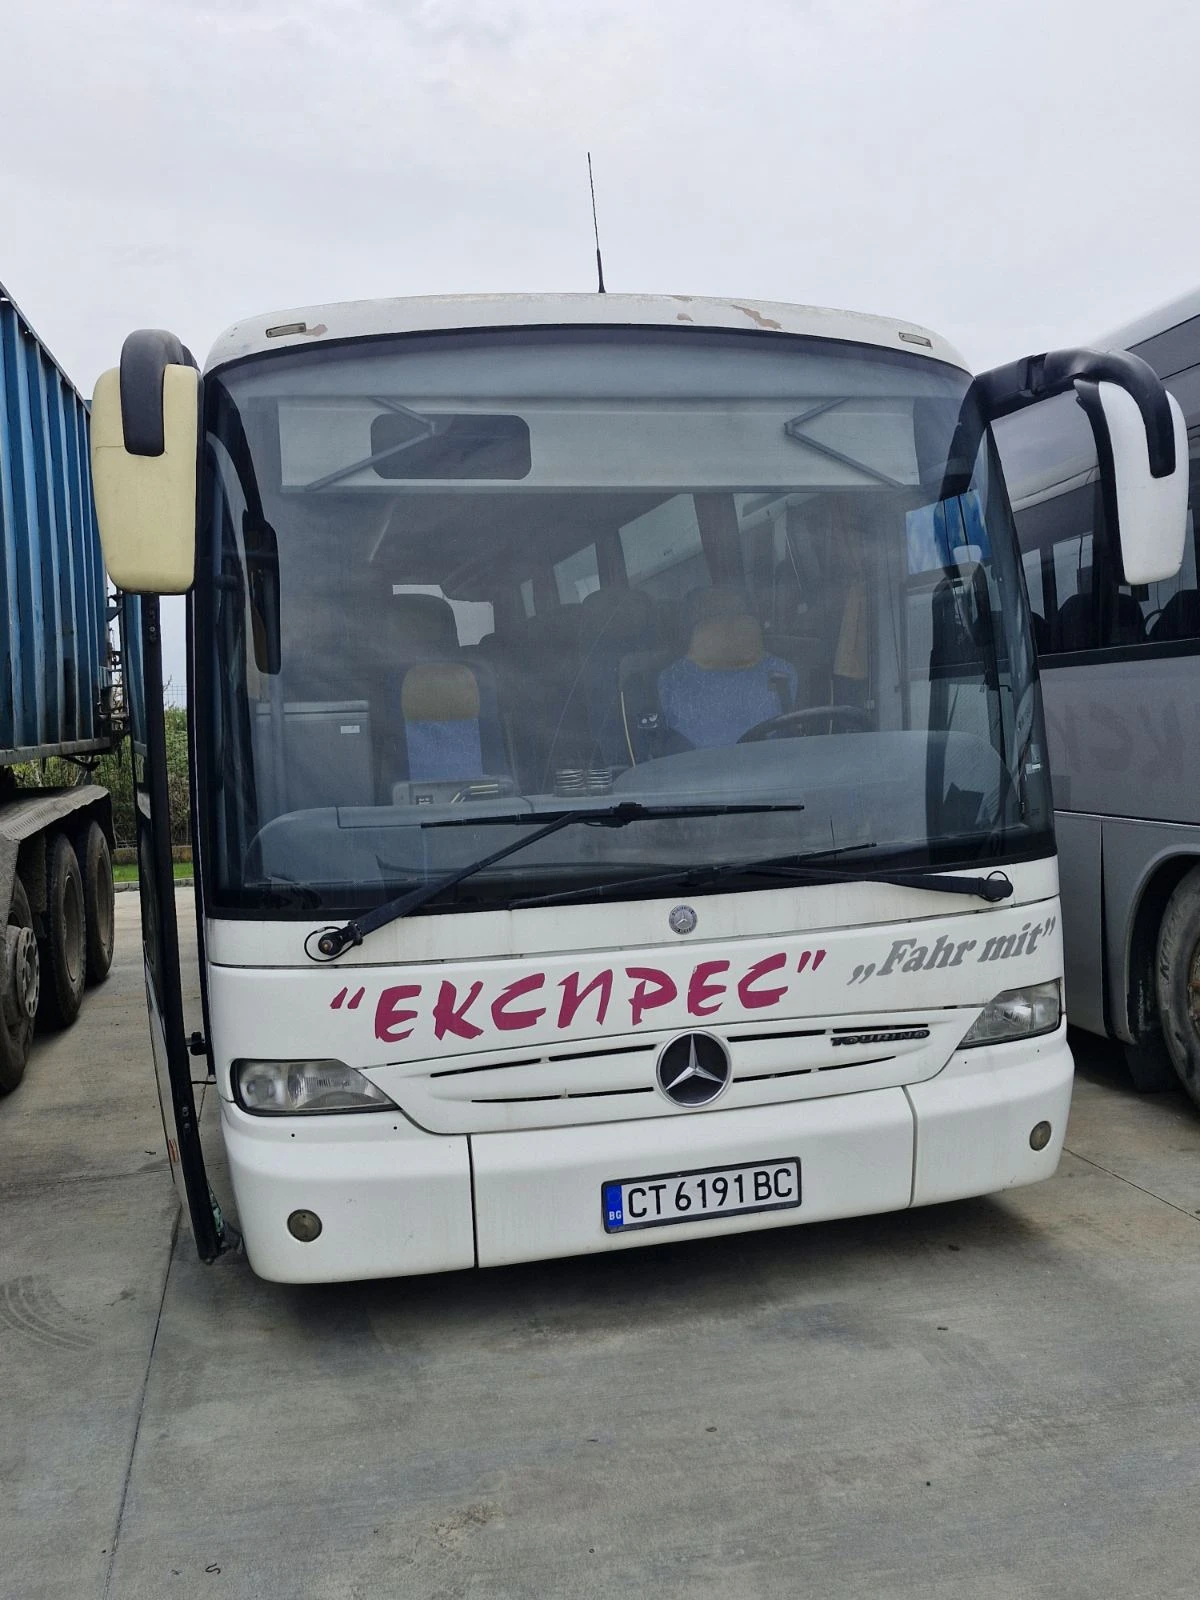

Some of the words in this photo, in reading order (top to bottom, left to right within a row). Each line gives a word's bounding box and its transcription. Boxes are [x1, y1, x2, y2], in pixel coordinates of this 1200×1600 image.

[628, 1184, 667, 1219] CT
[674, 1173, 744, 1212] 6191
[753, 1168, 793, 1202] BC
[608, 1210, 622, 1221] BG
